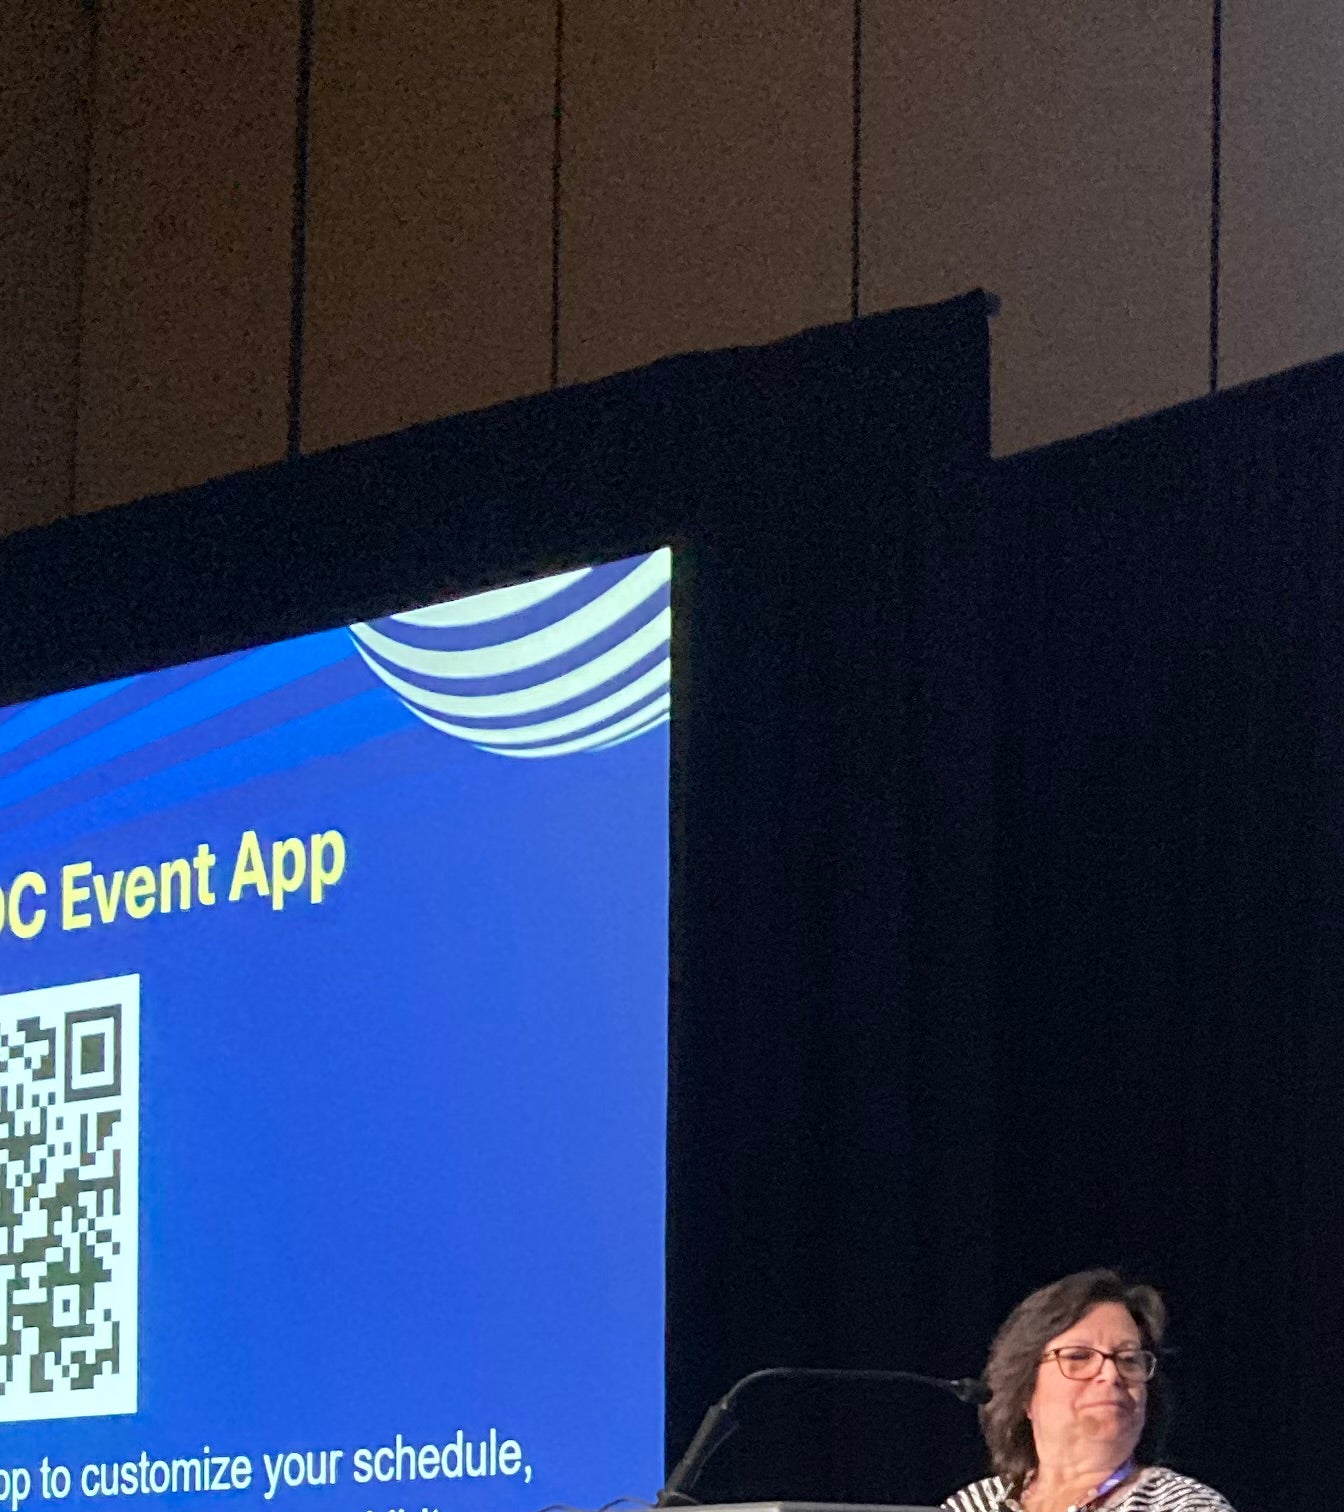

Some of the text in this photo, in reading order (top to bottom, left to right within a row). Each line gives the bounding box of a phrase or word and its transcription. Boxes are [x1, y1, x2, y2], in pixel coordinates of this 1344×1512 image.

[0, 830, 346, 939] C Event App
[40, 1456, 71, 1499] to
[81, 1446, 252, 1497] customize
[263, 1450, 343, 1500] your
[353, 1428, 532, 1484] schedule,
